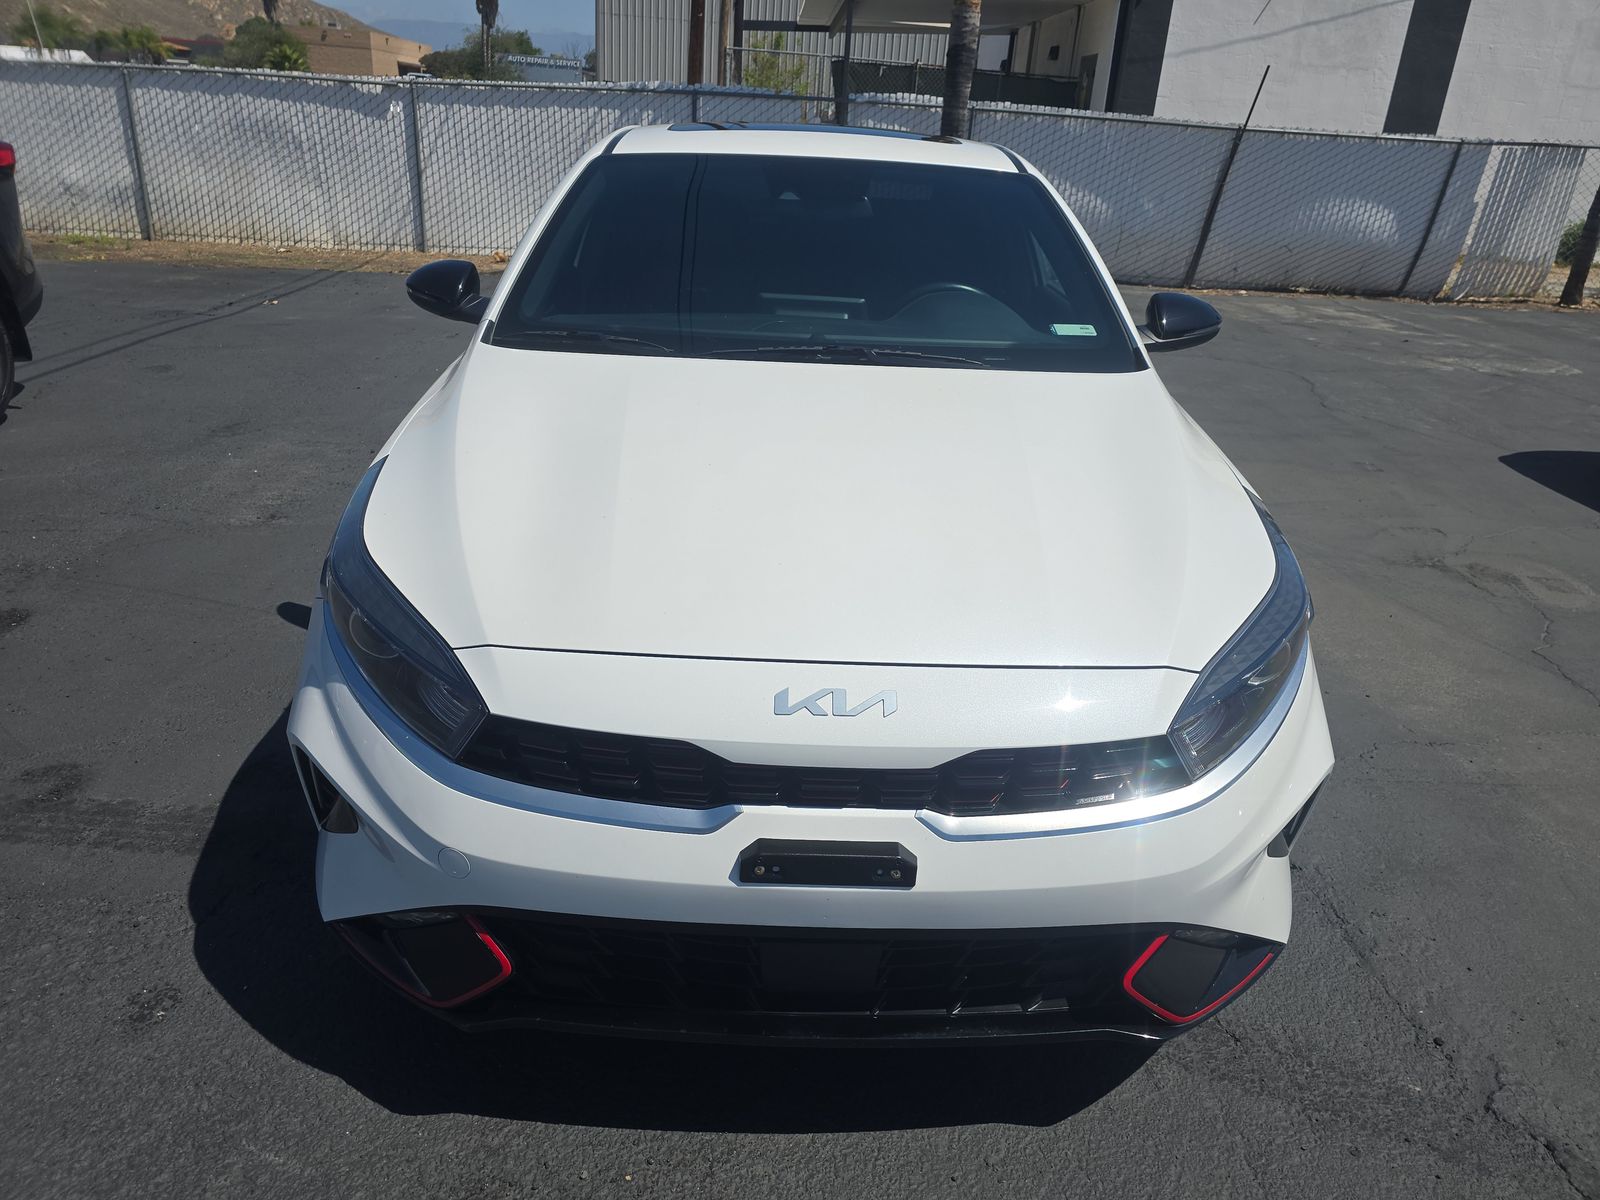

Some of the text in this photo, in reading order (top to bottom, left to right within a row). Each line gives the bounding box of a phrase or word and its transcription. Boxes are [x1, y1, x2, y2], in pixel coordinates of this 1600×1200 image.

[508, 55, 526, 63] AUTO
[527, 57, 549, 65] REPAIR
[556, 59, 580, 68] SERVICE
